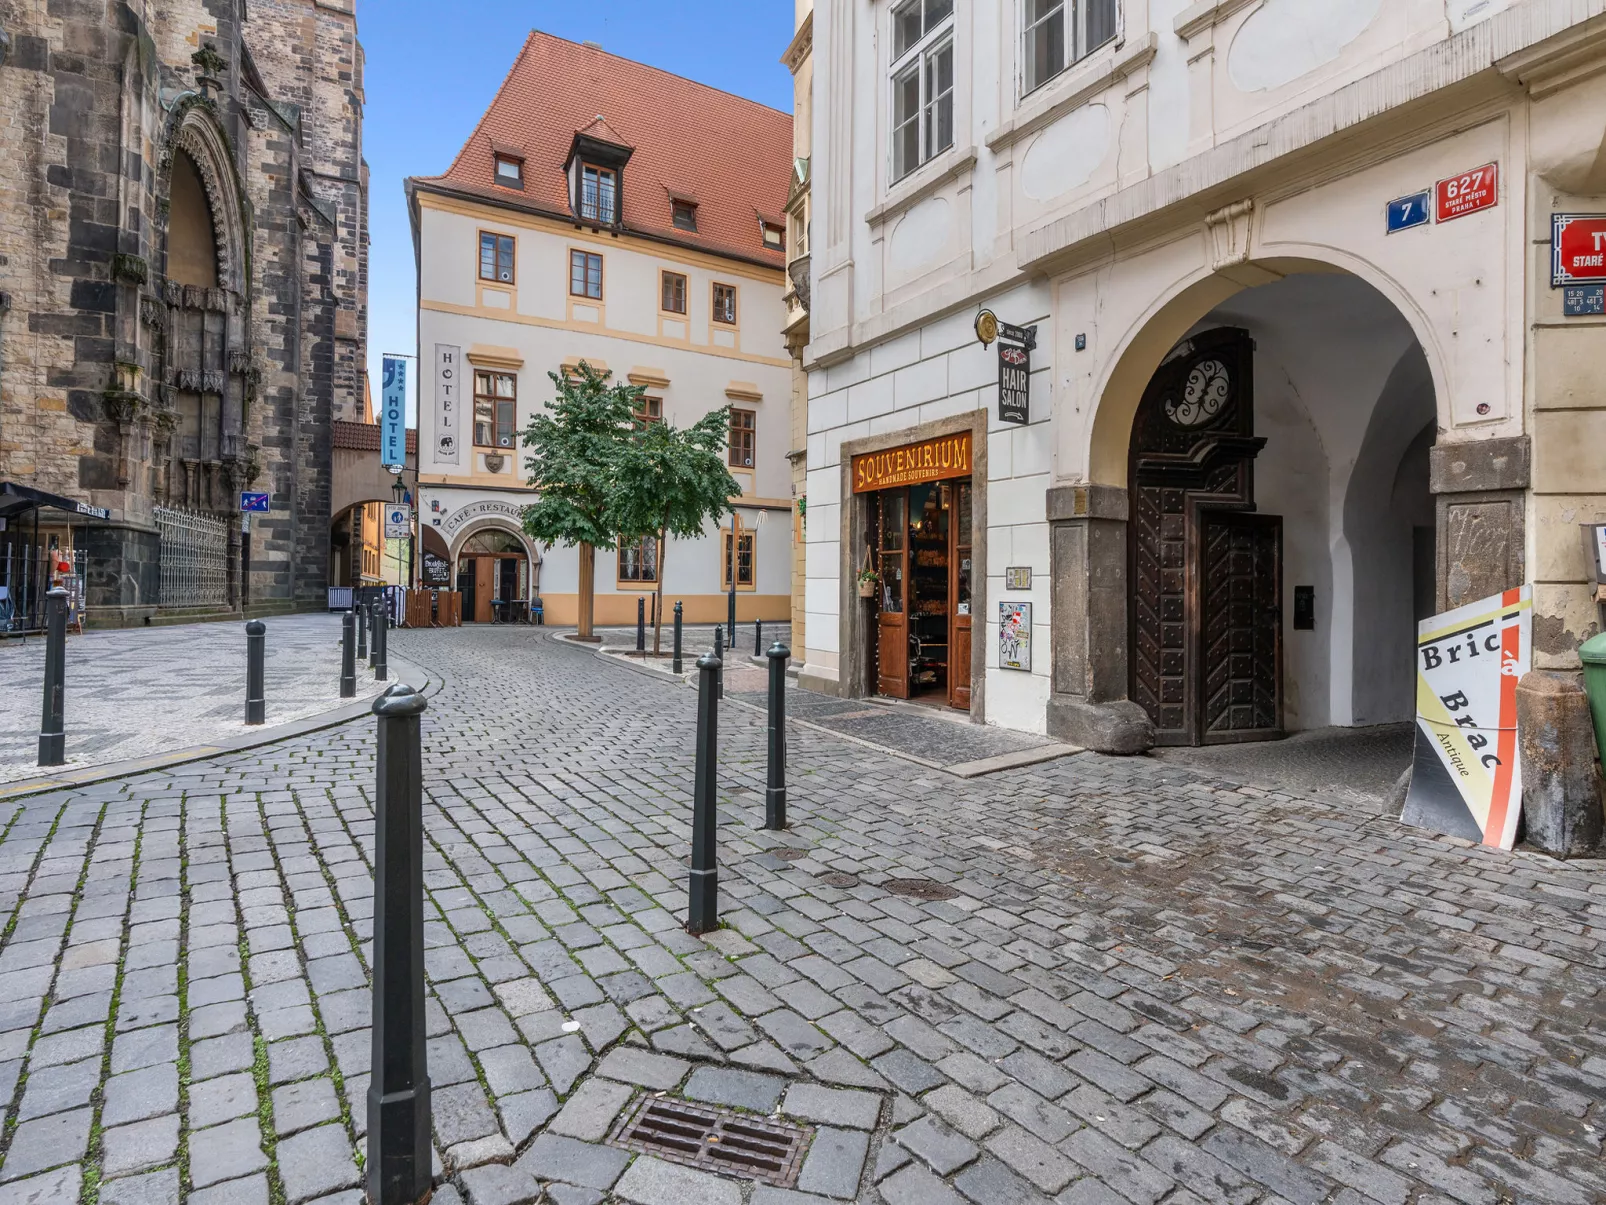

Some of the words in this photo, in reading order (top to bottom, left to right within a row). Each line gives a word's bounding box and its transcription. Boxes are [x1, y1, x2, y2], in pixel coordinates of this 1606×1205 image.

[1447, 171, 1483, 198] 627
[1445, 195, 1463, 208] STARÉ
[1465, 189, 1487, 201] MĚSTO
[1451, 202, 1473, 213] PRAHA
[1401, 202, 1412, 221] 7
[1573, 253, 1604, 267] STARÉ
[442, 353, 453, 427] HOTEL
[1002, 367, 1026, 391] HAIR
[1002, 389, 1027, 408] SALON
[388, 395, 399, 460] HOTEL
[858, 437, 967, 488] SOUVENIRIUM
[878, 473, 907, 485] HANDMADE
[908, 469, 939, 480] SOUVENIRS
[1421, 633, 1500, 670] Bric
[1501, 650, 1519, 676] à
[1440, 690, 1502, 769] Brac
[1436, 732, 1469, 777] Antique
